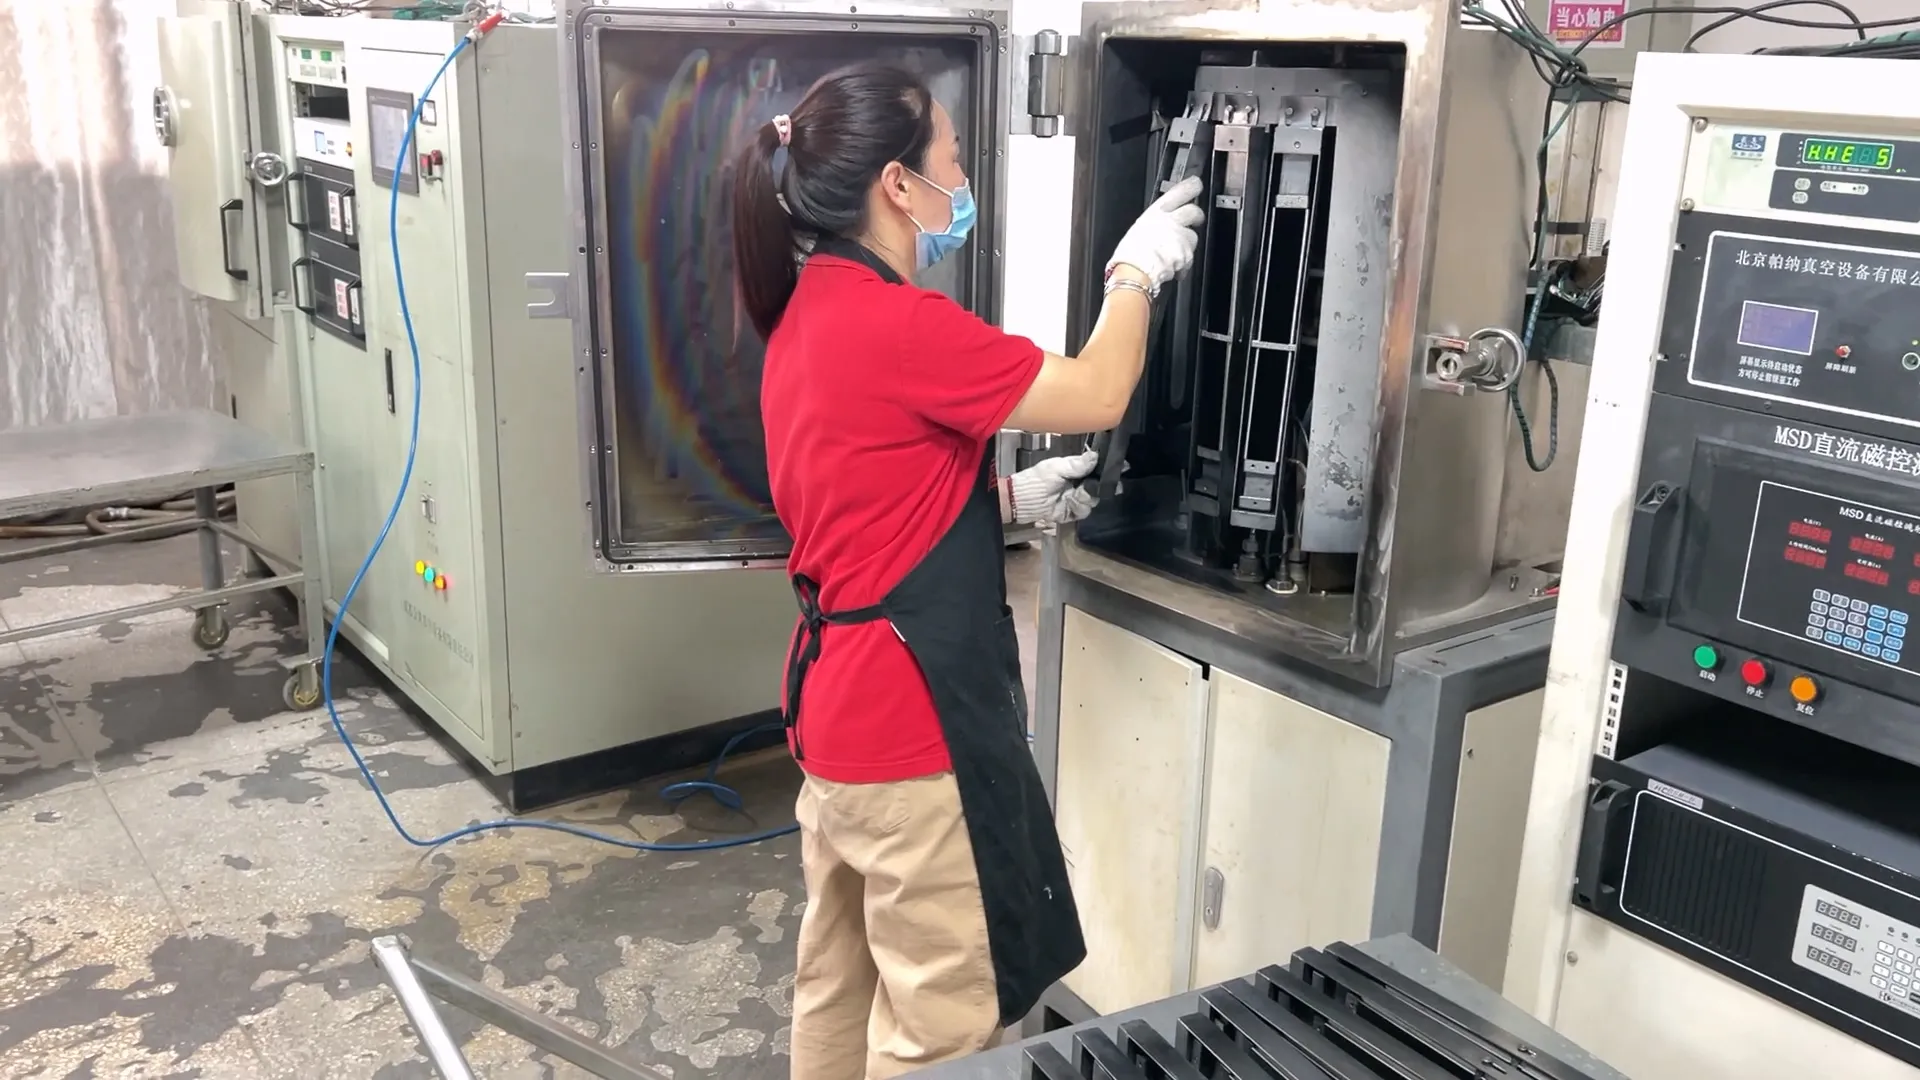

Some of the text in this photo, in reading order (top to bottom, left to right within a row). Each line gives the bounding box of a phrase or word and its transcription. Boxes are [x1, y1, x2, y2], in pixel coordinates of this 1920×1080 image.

[1839, 506, 1864, 520] MSD
[1699, 670, 1716, 682] 启动
[1746, 686, 1764, 698] 停止
[1795, 702, 1814, 716] 复位
